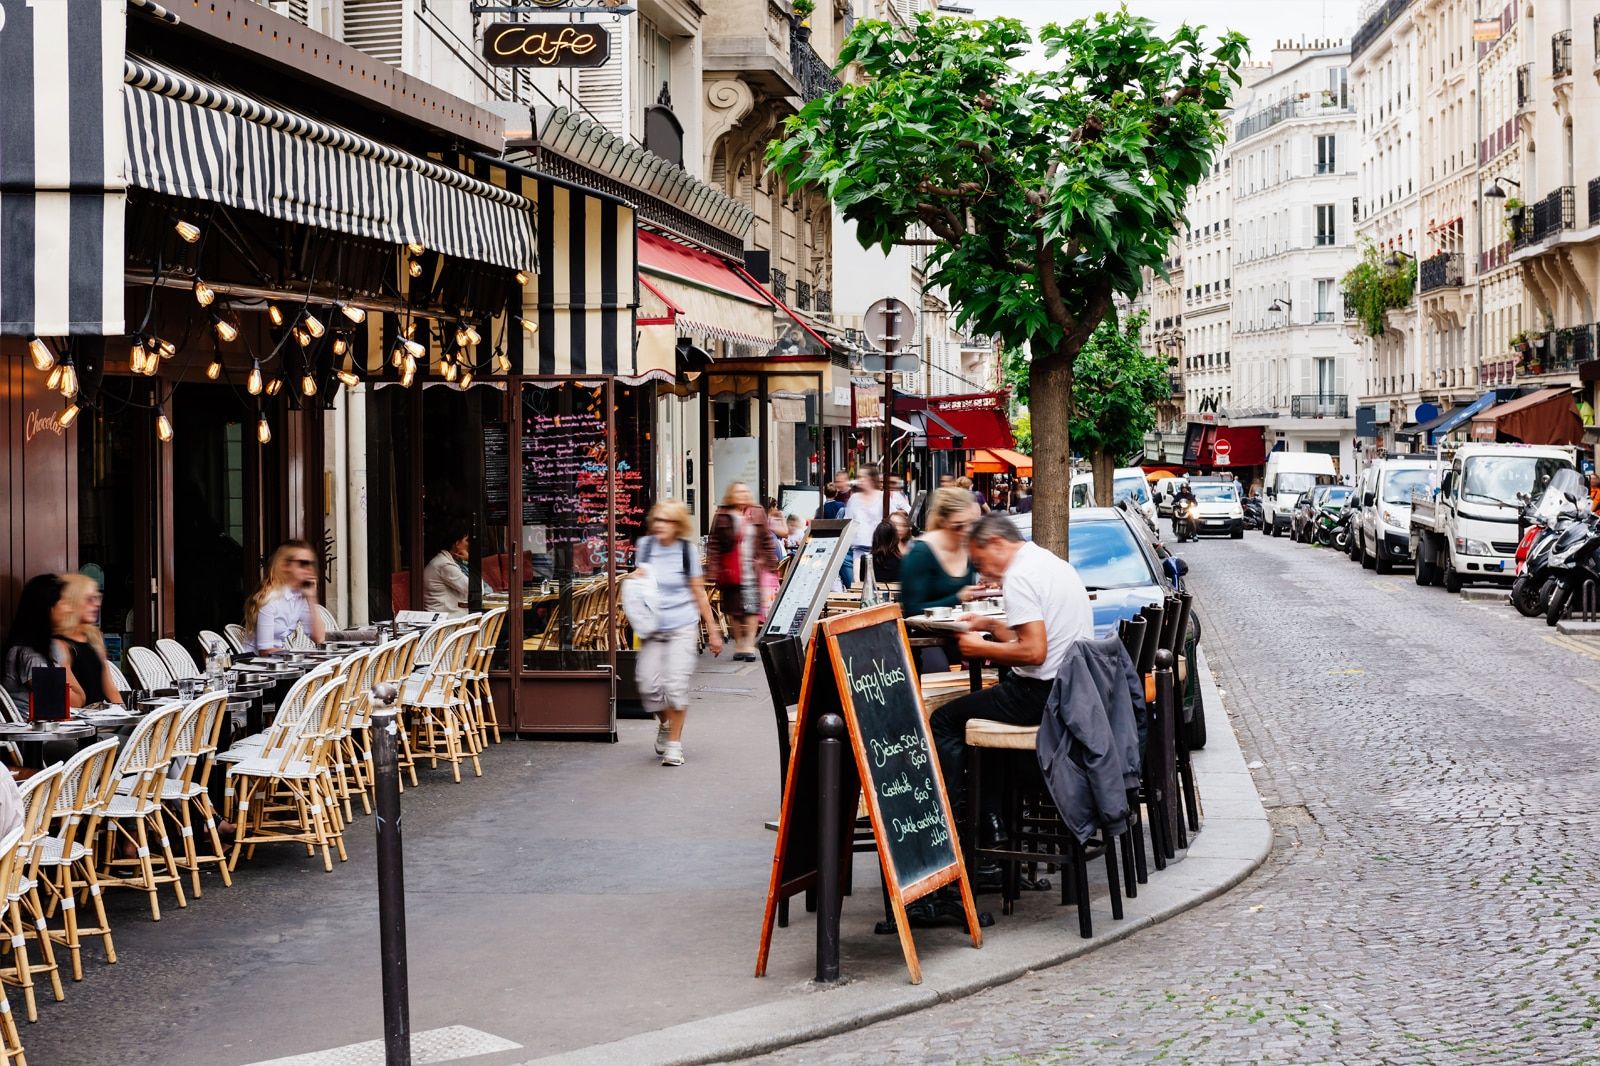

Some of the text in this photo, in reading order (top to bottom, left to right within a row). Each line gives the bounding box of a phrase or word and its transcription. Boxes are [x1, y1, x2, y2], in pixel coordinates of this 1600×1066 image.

[841, 656, 905, 705] Happy Hours
[892, 815, 919, 842] Double
